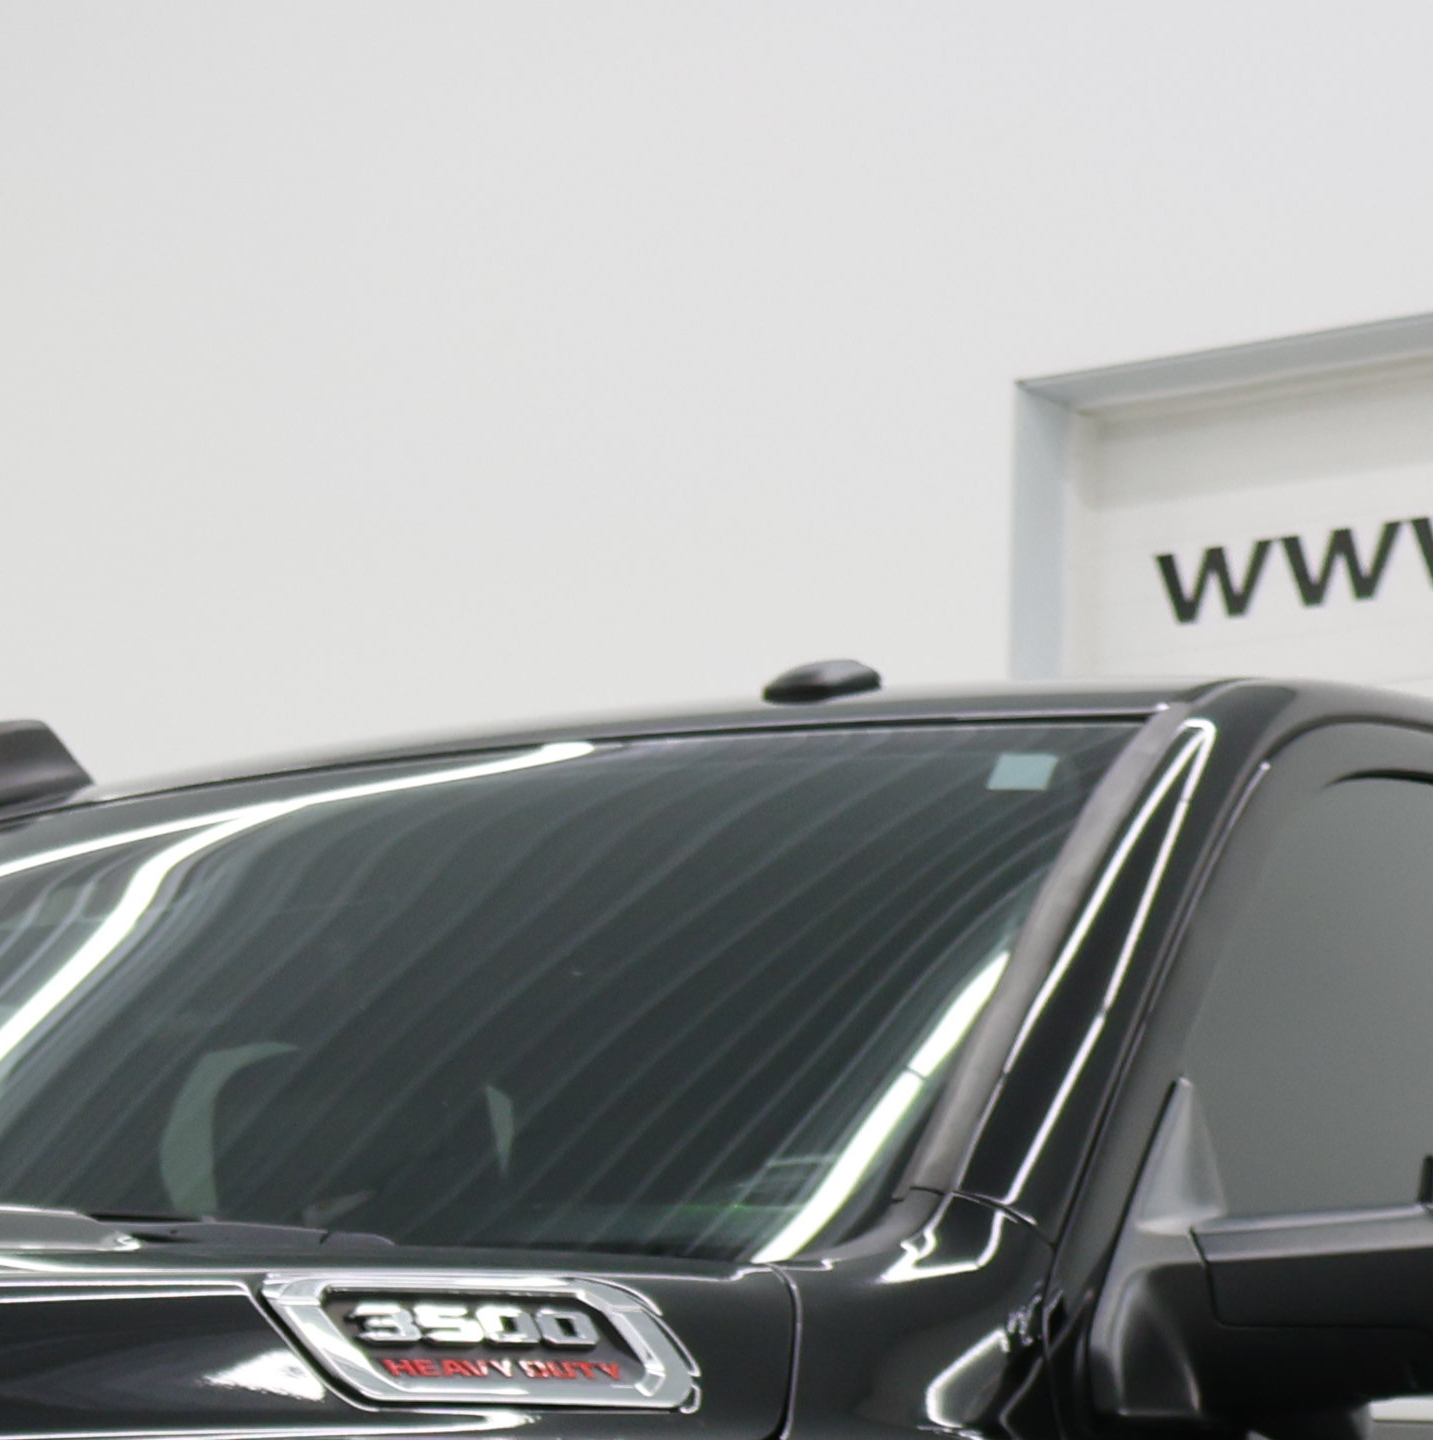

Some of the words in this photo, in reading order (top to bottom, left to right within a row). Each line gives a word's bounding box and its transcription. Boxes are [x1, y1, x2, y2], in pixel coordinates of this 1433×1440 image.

[347, 1303, 600, 1348] 3500
[382, 1357, 513, 1378] HEAVY
[521, 1360, 622, 1381] DUTY
